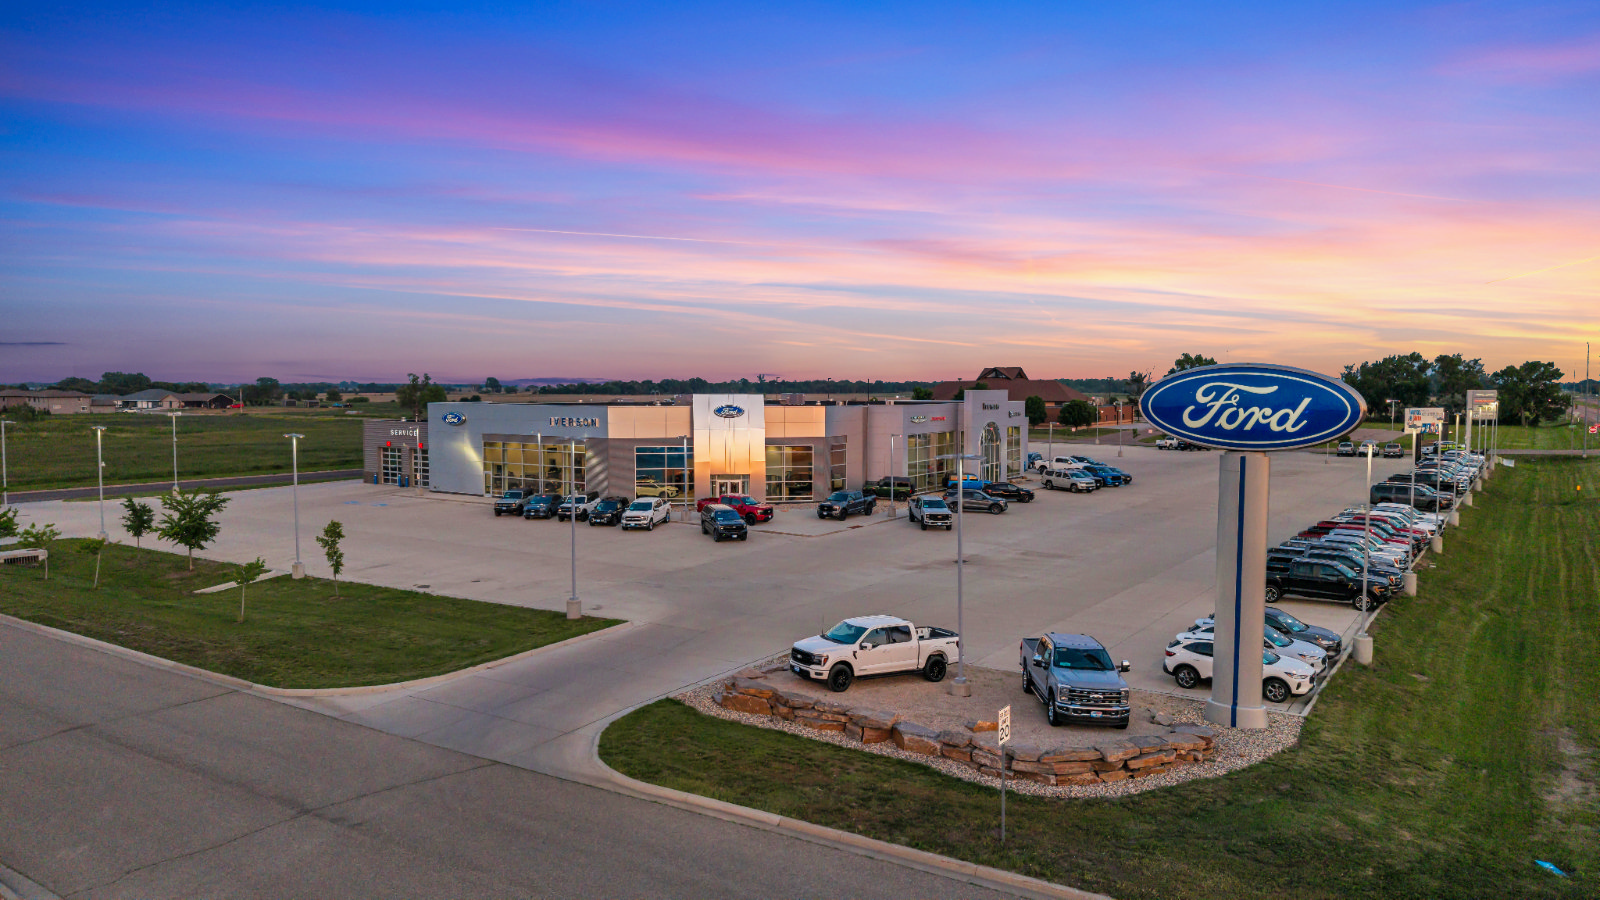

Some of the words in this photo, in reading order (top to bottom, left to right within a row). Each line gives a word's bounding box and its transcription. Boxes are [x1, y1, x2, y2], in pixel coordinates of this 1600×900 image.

[1182, 381, 1313, 433] Ford
[445, 414, 459, 422] Ford
[549, 417, 599, 428] IVERSON
[390, 429, 417, 437] SERVICE
[999, 724, 1010, 741] 20
